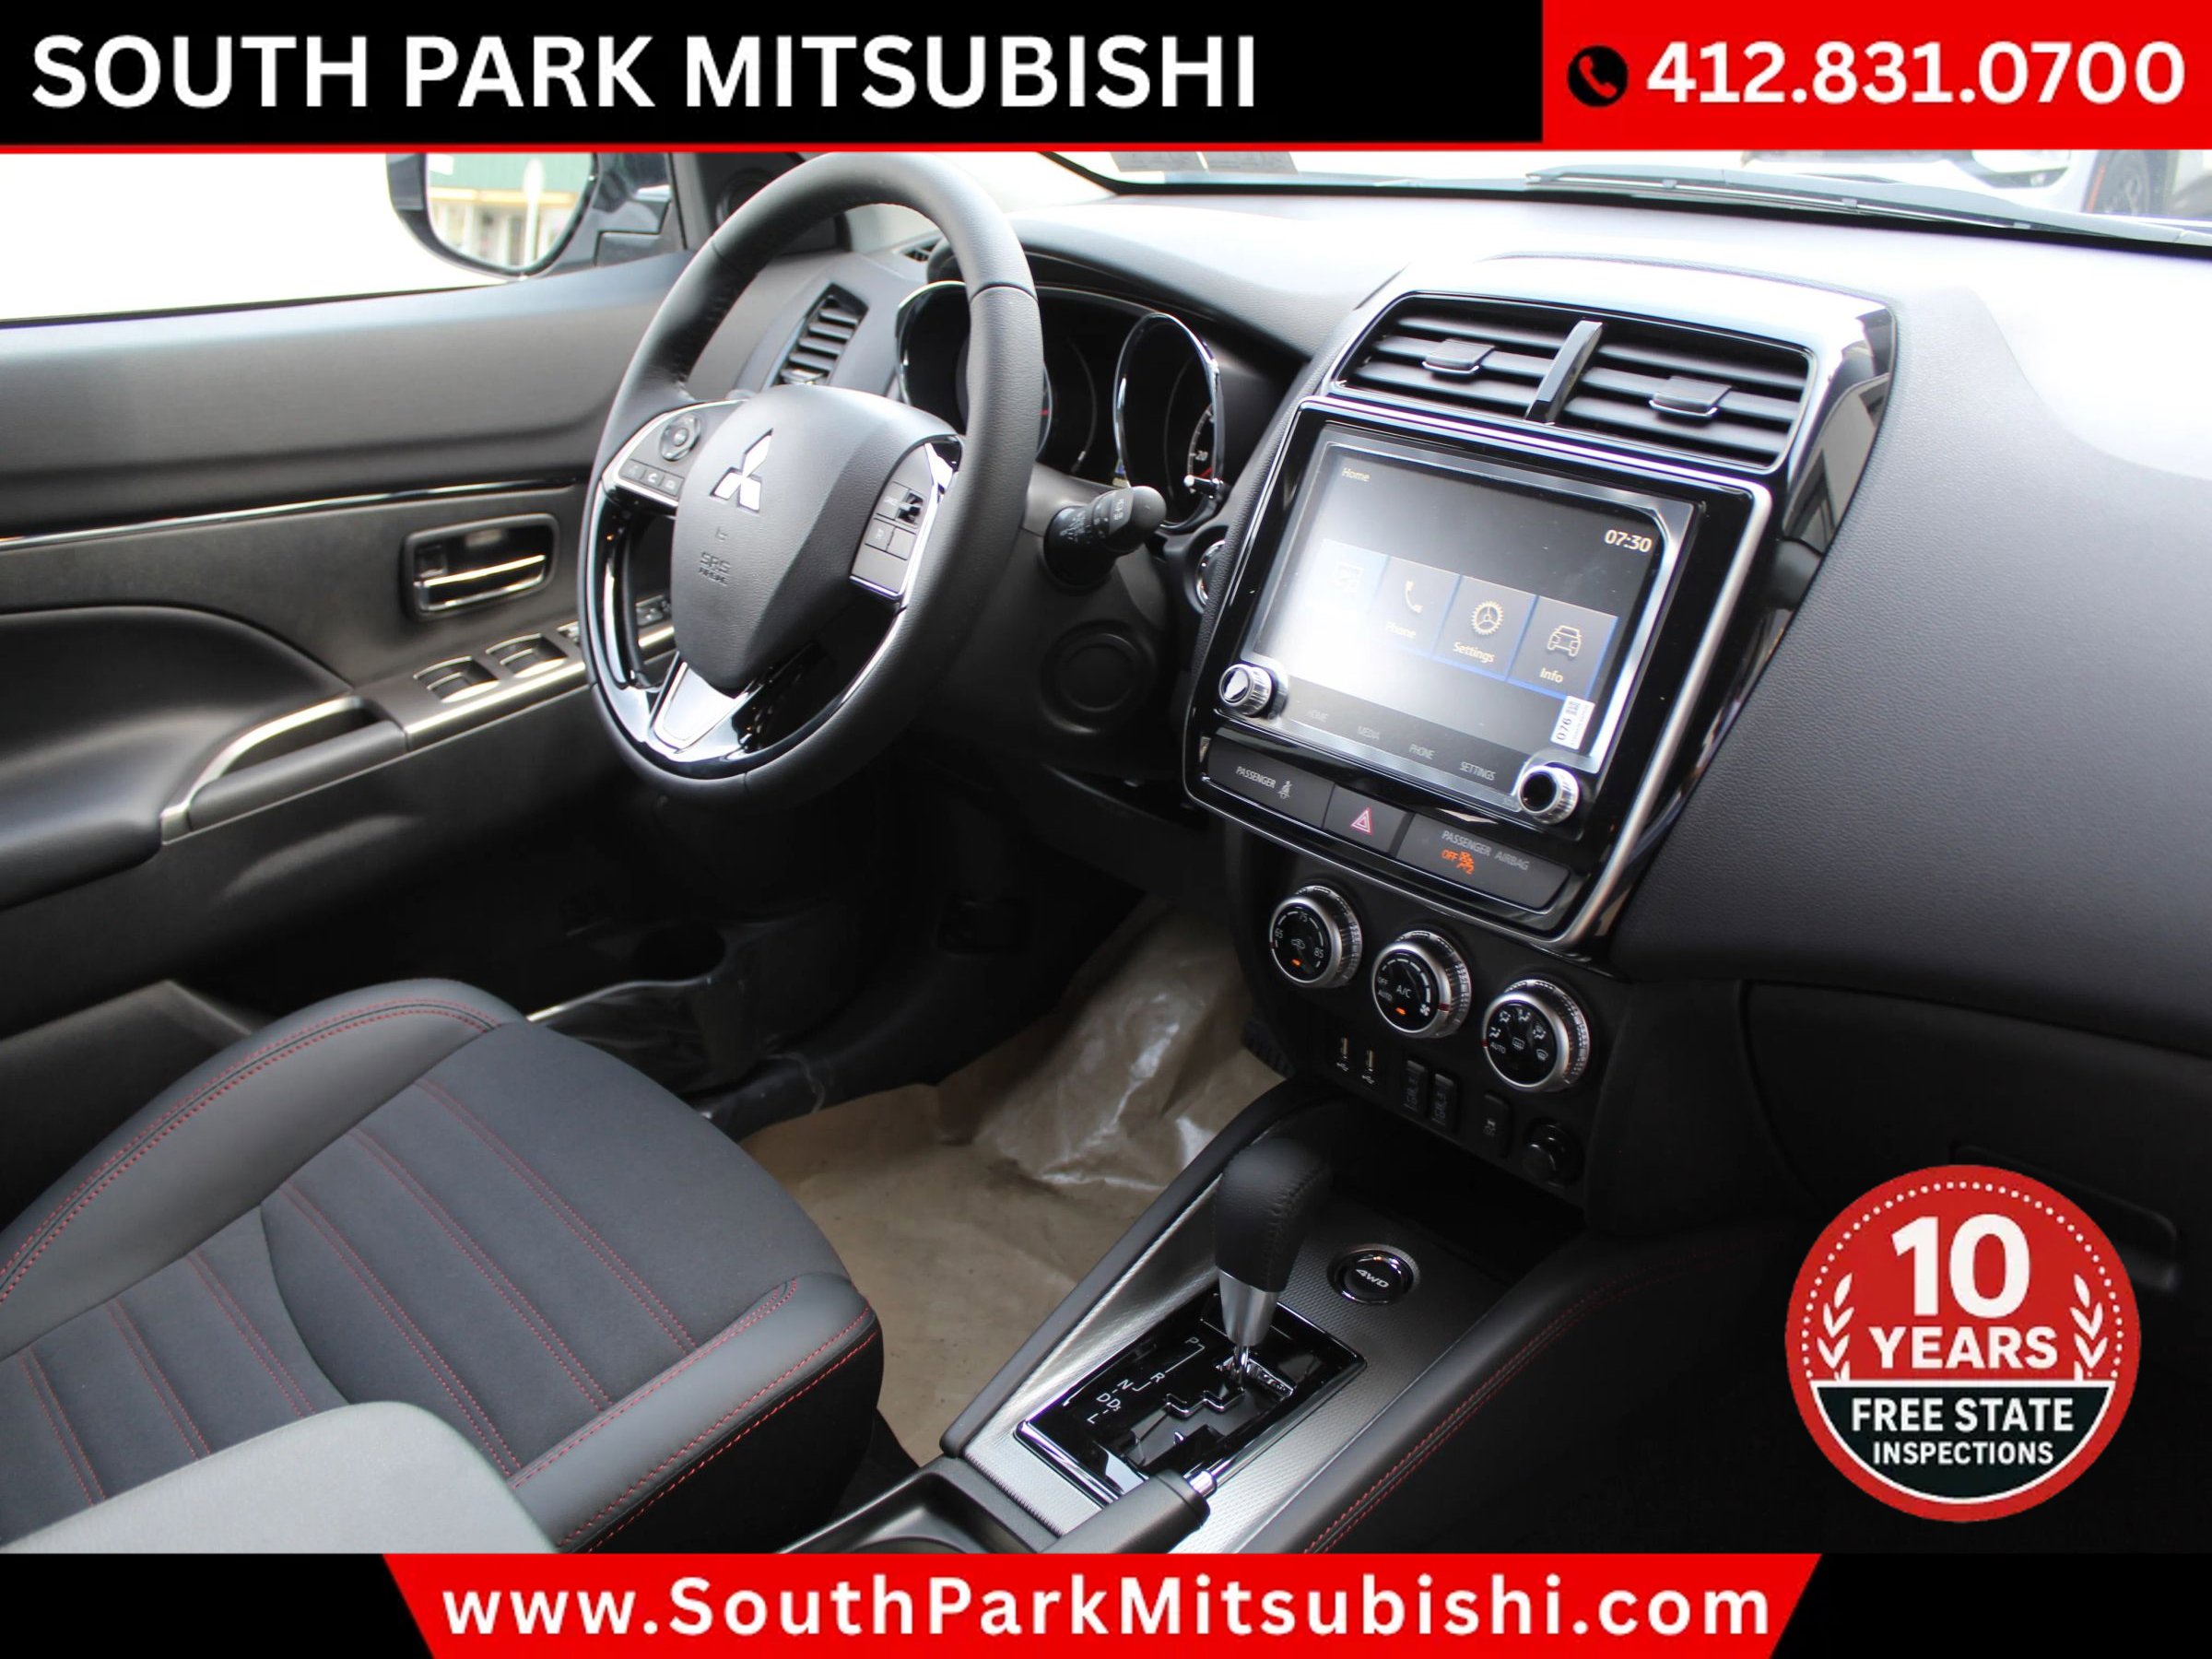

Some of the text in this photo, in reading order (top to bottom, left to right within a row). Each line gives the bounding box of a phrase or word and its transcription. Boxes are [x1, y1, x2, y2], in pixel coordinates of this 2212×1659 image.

[1342, 467, 1371, 482] Home
[1605, 529, 1653, 552] 07:30
[1384, 621, 1417, 639] Phone
[1453, 641, 1495, 664] Settings
[1539, 667, 1564, 684] Info
[1409, 743, 1436, 760] PHONE
[1236, 766, 1277, 789] PASSENGER
[1460, 761, 1496, 781] SETTINGS
[1441, 830, 1530, 871] PASSENGER AIRBAG
[1441, 849, 1458, 862] OFF
[1313, 947, 1324, 959] 85
[1396, 984, 1412, 999] A/C
[1490, 1041, 1506, 1054] AUTO
[1356, 1268, 1390, 1288] 4WD
[1184, 1336, 1199, 1345] P
[1117, 1379, 1135, 1390] N
[1150, 1371, 1166, 1383] R
[1095, 1393, 1112, 1403] D
[1087, 1413, 1099, 1424] L
